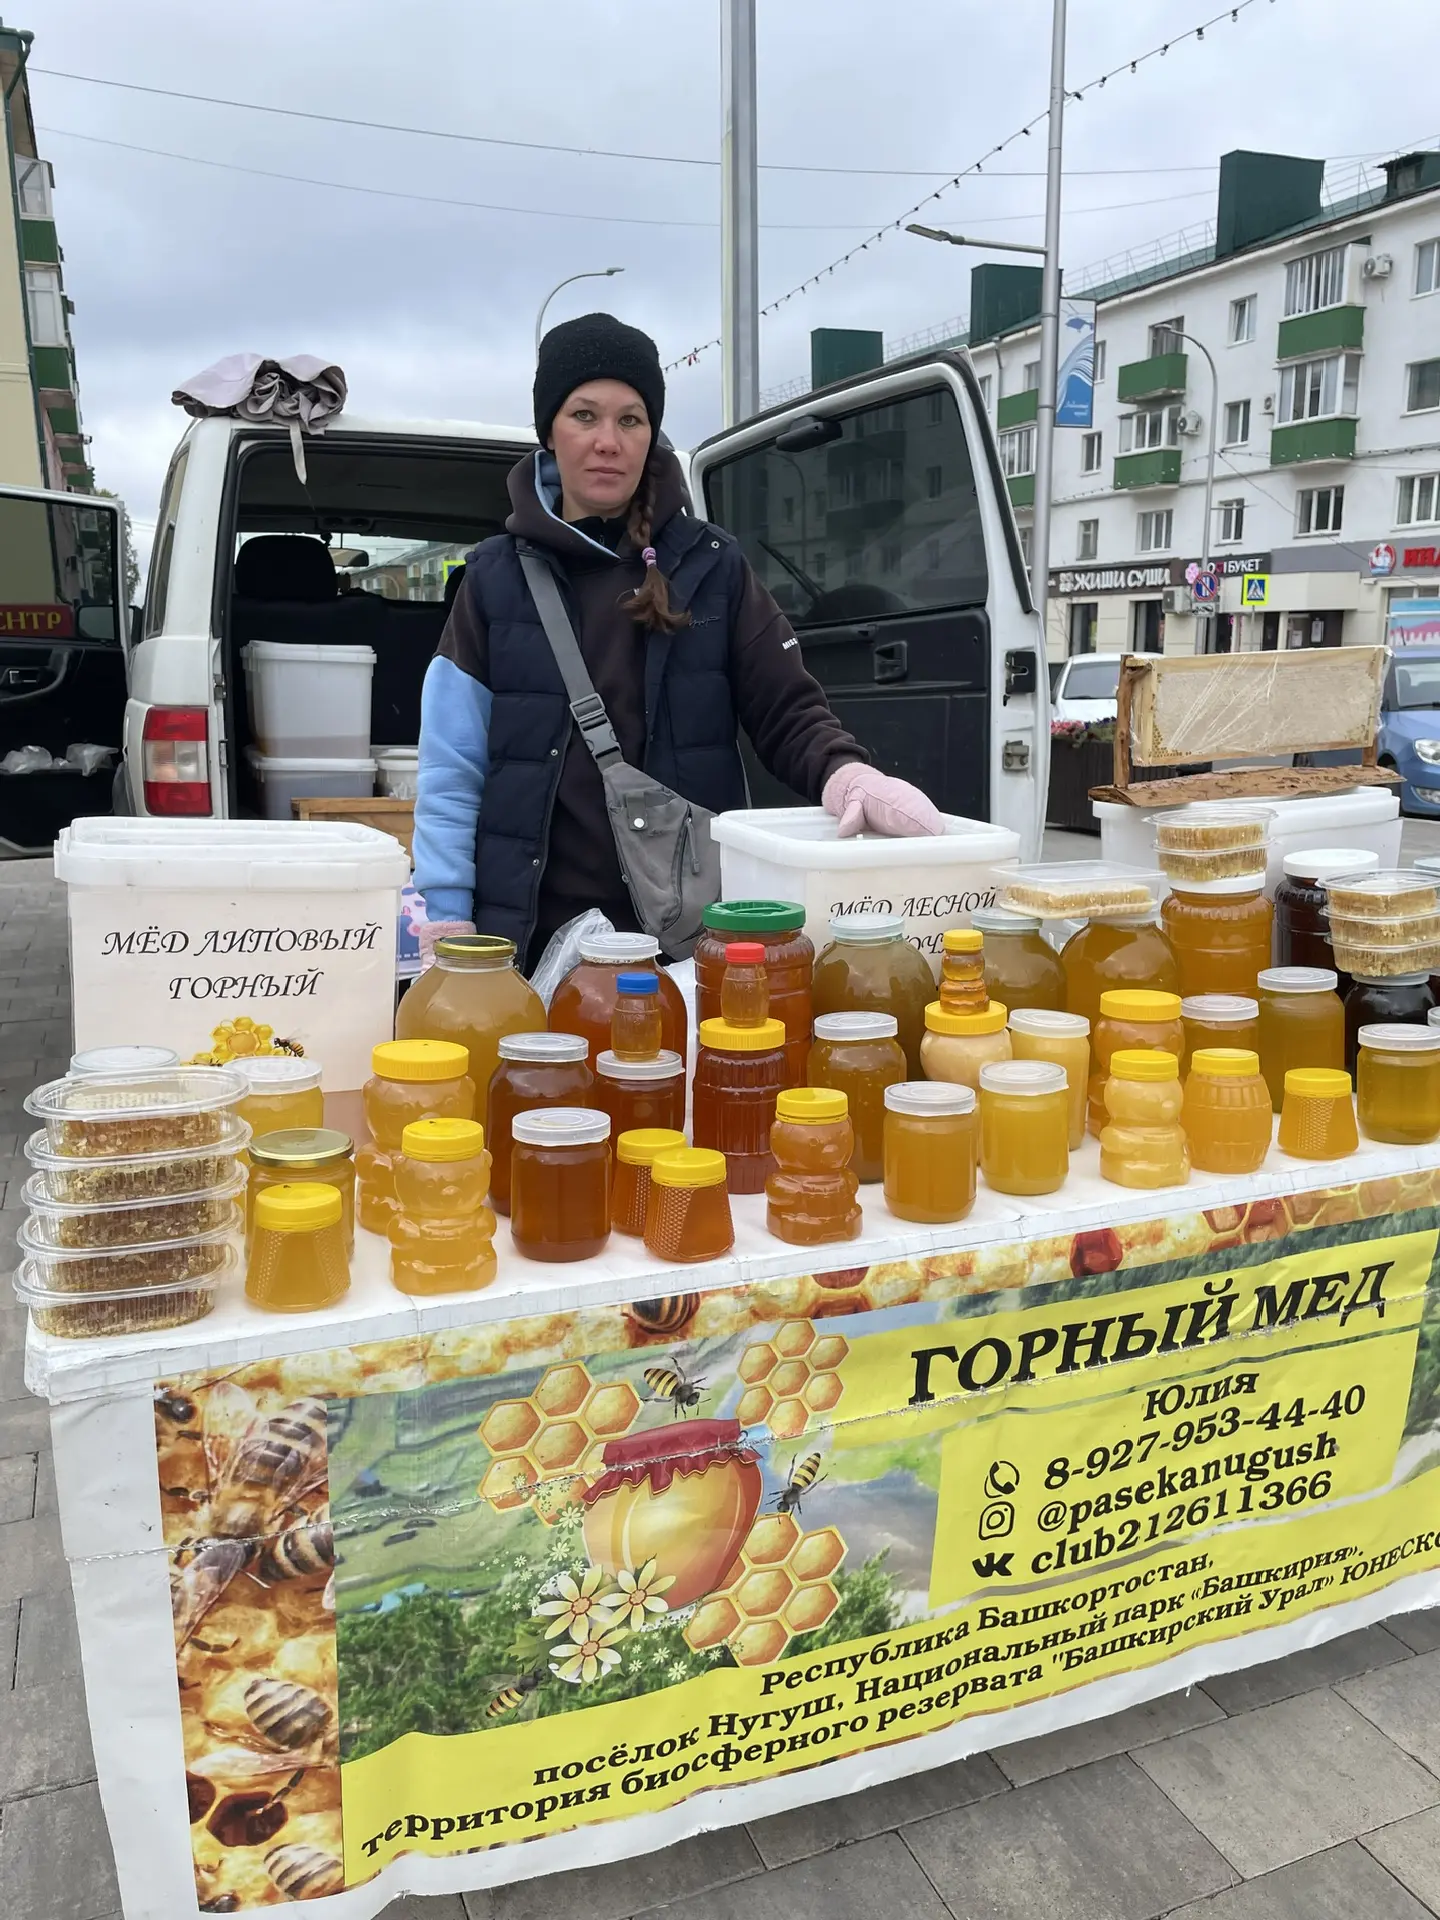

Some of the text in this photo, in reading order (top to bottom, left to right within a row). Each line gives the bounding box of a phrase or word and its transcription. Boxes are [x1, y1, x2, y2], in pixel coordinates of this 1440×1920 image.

[1074, 567, 1172, 591] ЖИШИ СУШИ
[1228, 558, 1262, 574] БУКЕТ
[101, 922, 383, 956] МЁД ЛИПОВЫЙ
[169, 967, 324, 1000] ГОРНЫЙ
[908, 1261, 1395, 1405] ГОРНЫЙ МЕД
[1045, 1384, 1366, 1490] 8-927-953-44-40
[1143, 1373, 1260, 1421] Юлия
[1031, 1470, 1333, 1574] club212611366
[1037, 1432, 1338, 1535] @pasekanugush
[760, 1553, 1214, 1697] Республика Башкортостан,
[533, 1727, 700, 1786] посёлок
[707, 1693, 844, 1741] Нугуш,
[854, 1615, 1107, 1705] Национальный
[1112, 1593, 1186, 1628] парк
[361, 1782, 611, 1858] территория
[621, 1713, 869, 1795] биосферного
[878, 1664, 1043, 1727] резервата
